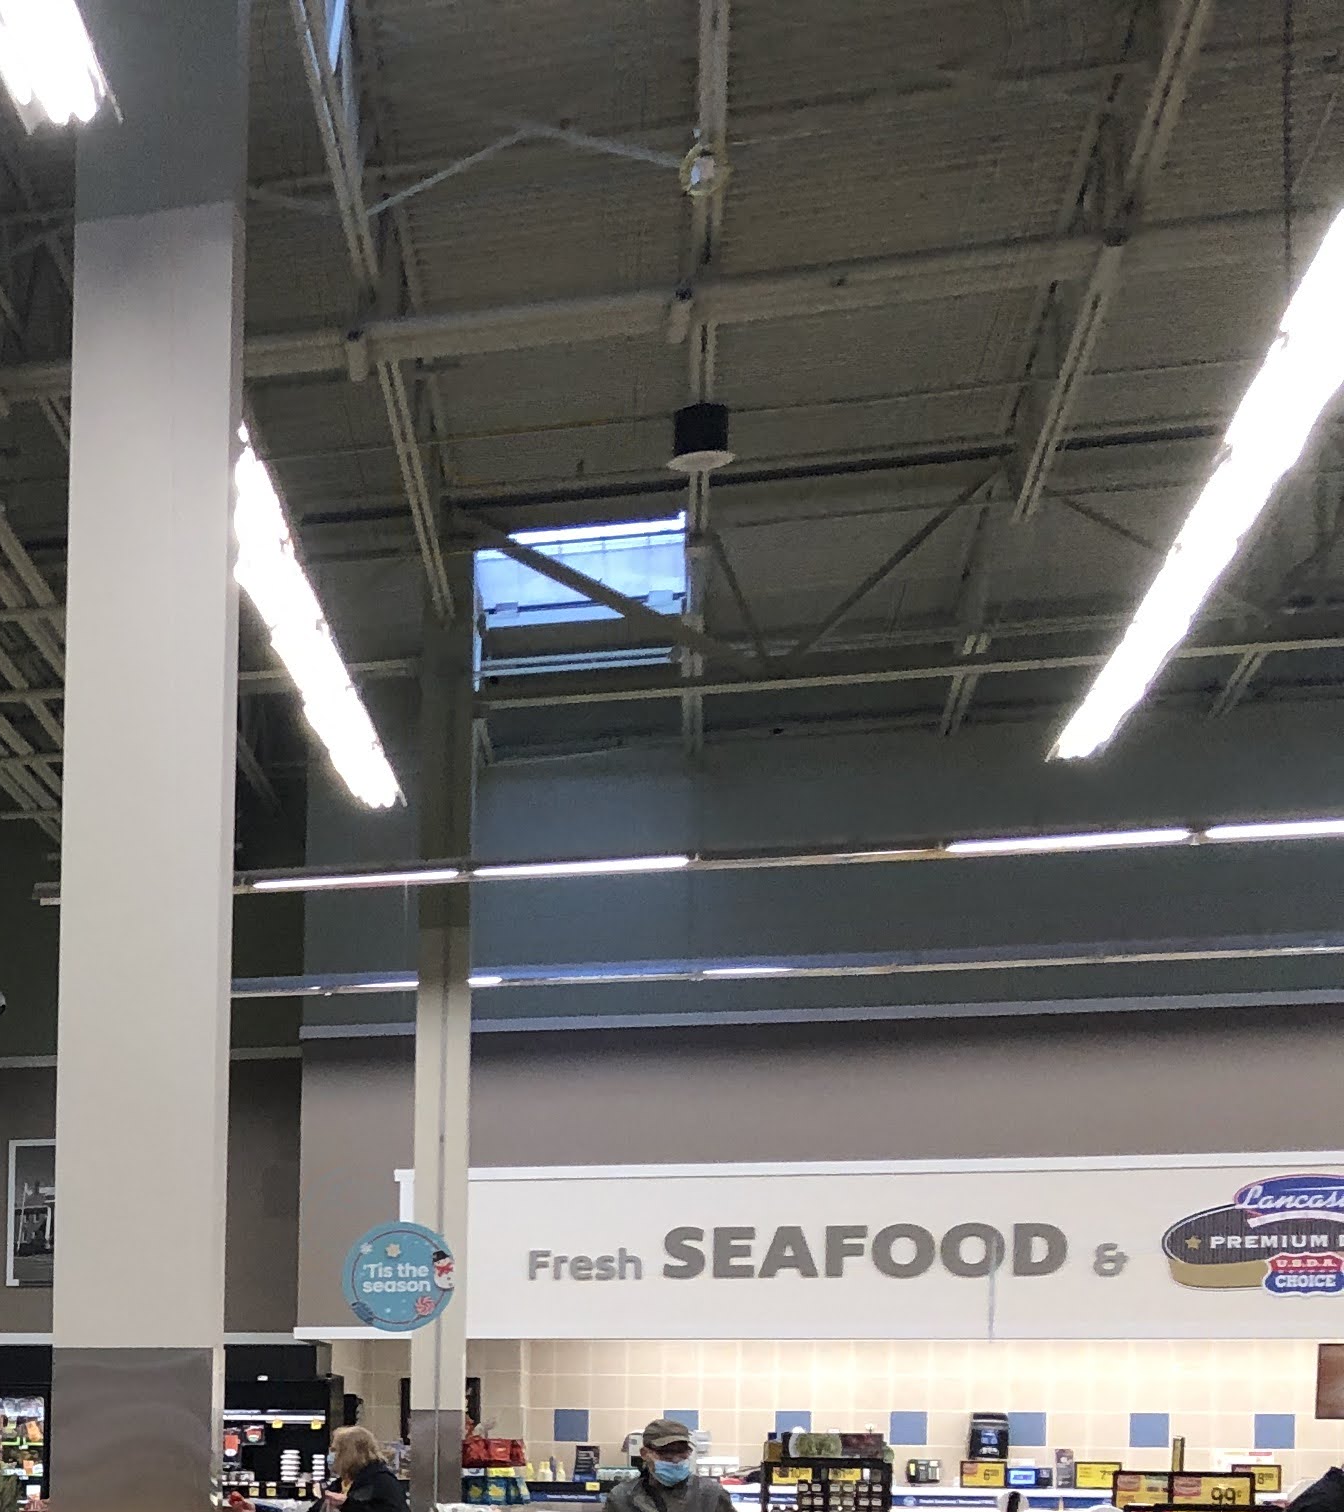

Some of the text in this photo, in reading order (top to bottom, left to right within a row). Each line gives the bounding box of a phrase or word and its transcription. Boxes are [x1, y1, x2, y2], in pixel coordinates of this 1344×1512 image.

[1210, 1234, 1329, 1249] PREMIUM
[528, 1221, 1128, 1281] Fresh SEAFOOD &
[362, 1262, 429, 1278] 'Tis the
[362, 1280, 431, 1293] season
[1275, 1274, 1337, 1287] CHOICE
